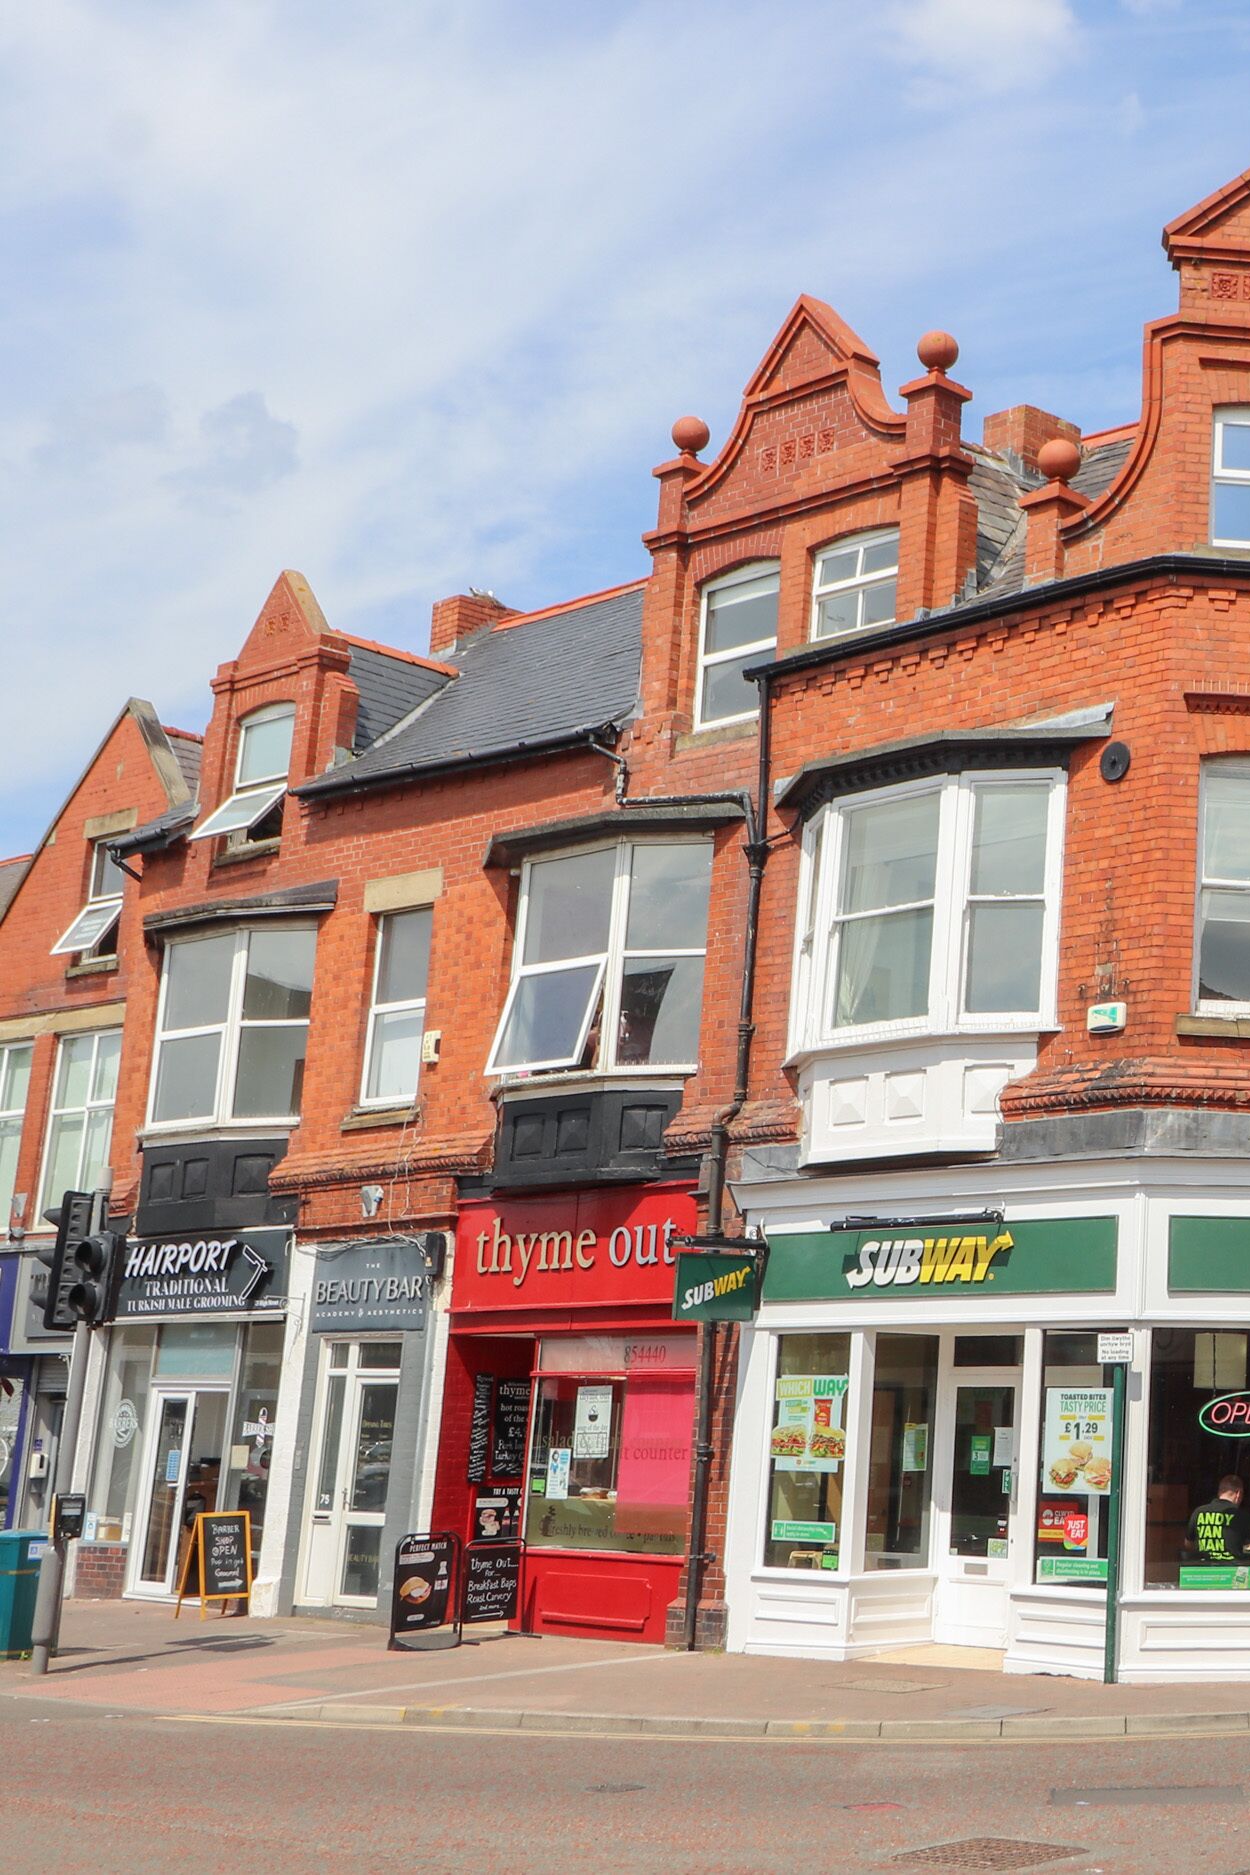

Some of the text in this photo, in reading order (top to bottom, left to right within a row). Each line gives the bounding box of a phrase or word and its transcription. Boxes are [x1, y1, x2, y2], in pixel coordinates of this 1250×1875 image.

[124, 1239, 237, 1278] HAIRPORT
[476, 1217, 677, 1287] thyme out
[845, 1230, 1014, 1289] SUBWAY
[144, 1277, 230, 1297] TRADITIONAL
[681, 1265, 752, 1310] SUBWAY
[127, 1299, 165, 1312] TURKISH
[167, 1298, 191, 1311] MALE
[193, 1295, 245, 1309] GROOMING
[316, 1310, 355, 1318] ACADEMY
[367, 1308, 424, 1316] AESTHETICS
[623, 1345, 666, 1364] 854440
[499, 1384, 531, 1398] thyme
[781, 1379, 849, 1396] WHICH WAY
[1060, 1393, 1107, 1401] TOASTED BITES
[500, 1403, 513, 1412] hot
[1060, 1401, 1106, 1412] TASTY PRICE
[504, 1415, 513, 1423] of
[513, 1414, 524, 1423] the
[542, 1430, 575, 1448] salad
[633, 1447, 688, 1461] counter
[319, 1494, 330, 1505] 75
[1054, 1518, 1065, 1526] EA
[1067, 1520, 1085, 1531] JUST
[1197, 1512, 1235, 1526] ANDY
[211, 1524, 240, 1535] BARBER
[1070, 1530, 1085, 1538] EAT
[1196, 1525, 1222, 1539] VAN
[215, 1536, 234, 1546] SHOP
[1199, 1539, 1225, 1552] MAN
[211, 1544, 238, 1556] OPEN
[468, 1578, 517, 1592] Breakfast Baps
[466, 1592, 513, 1604] Roast Carvery
